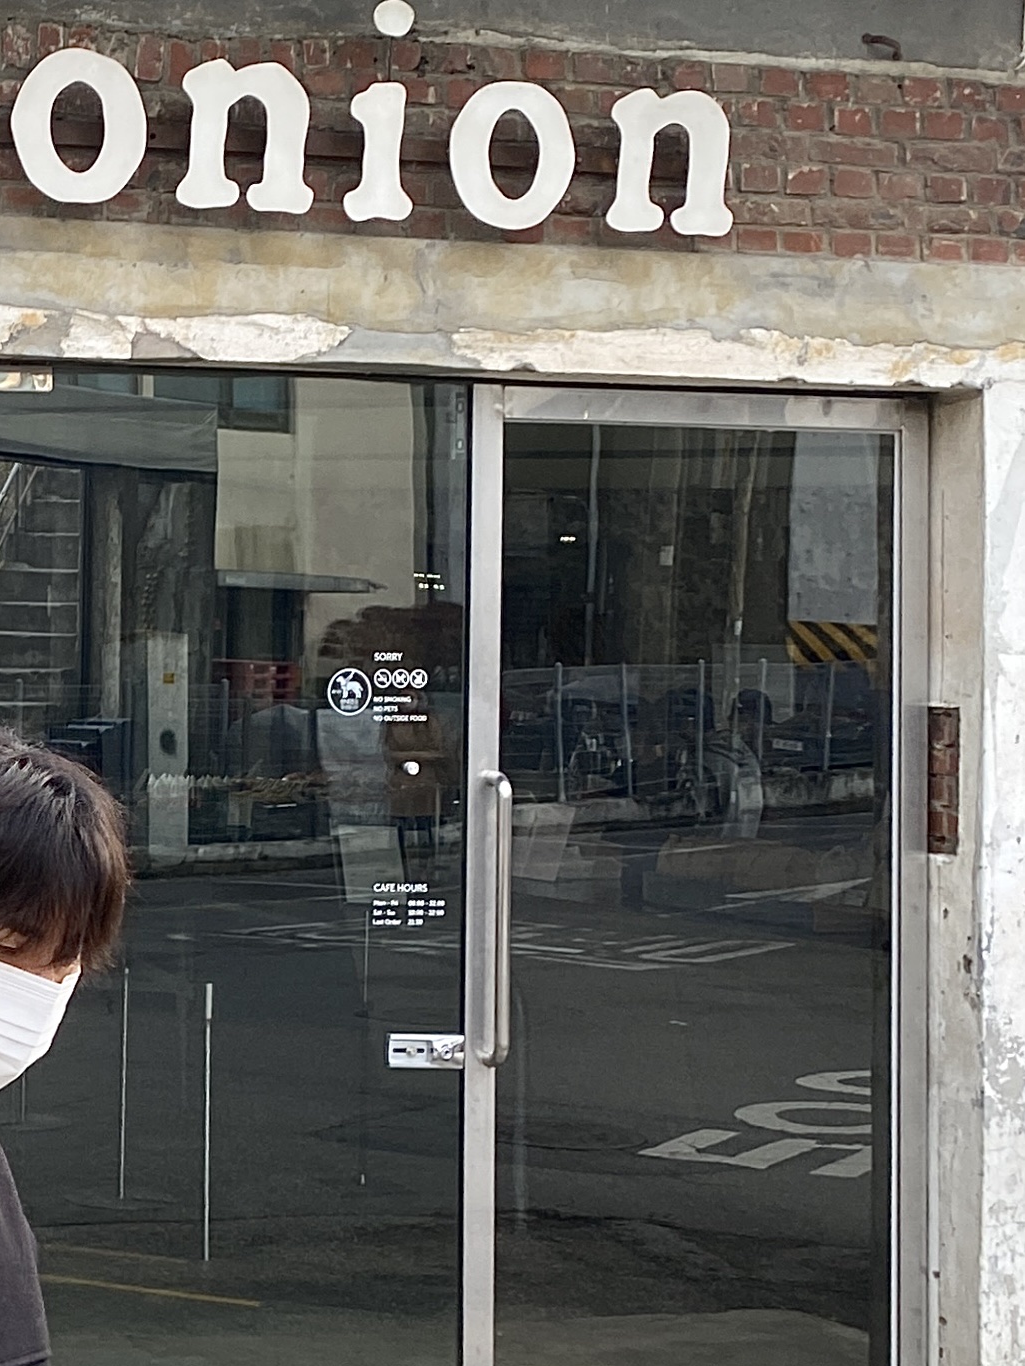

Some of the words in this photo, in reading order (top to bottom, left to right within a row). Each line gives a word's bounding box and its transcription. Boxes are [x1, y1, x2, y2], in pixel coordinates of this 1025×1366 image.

[11, 0, 734, 237] onion
[373, 652, 403, 662] SORRY
[384, 695, 412, 703] SMOKING
[373, 714, 383, 722] NO
[384, 714, 409, 722] OUTSIDE
[410, 714, 428, 722] FOOD
[373, 883, 396, 893] CAFE
[396, 883, 428, 893] HOURS
